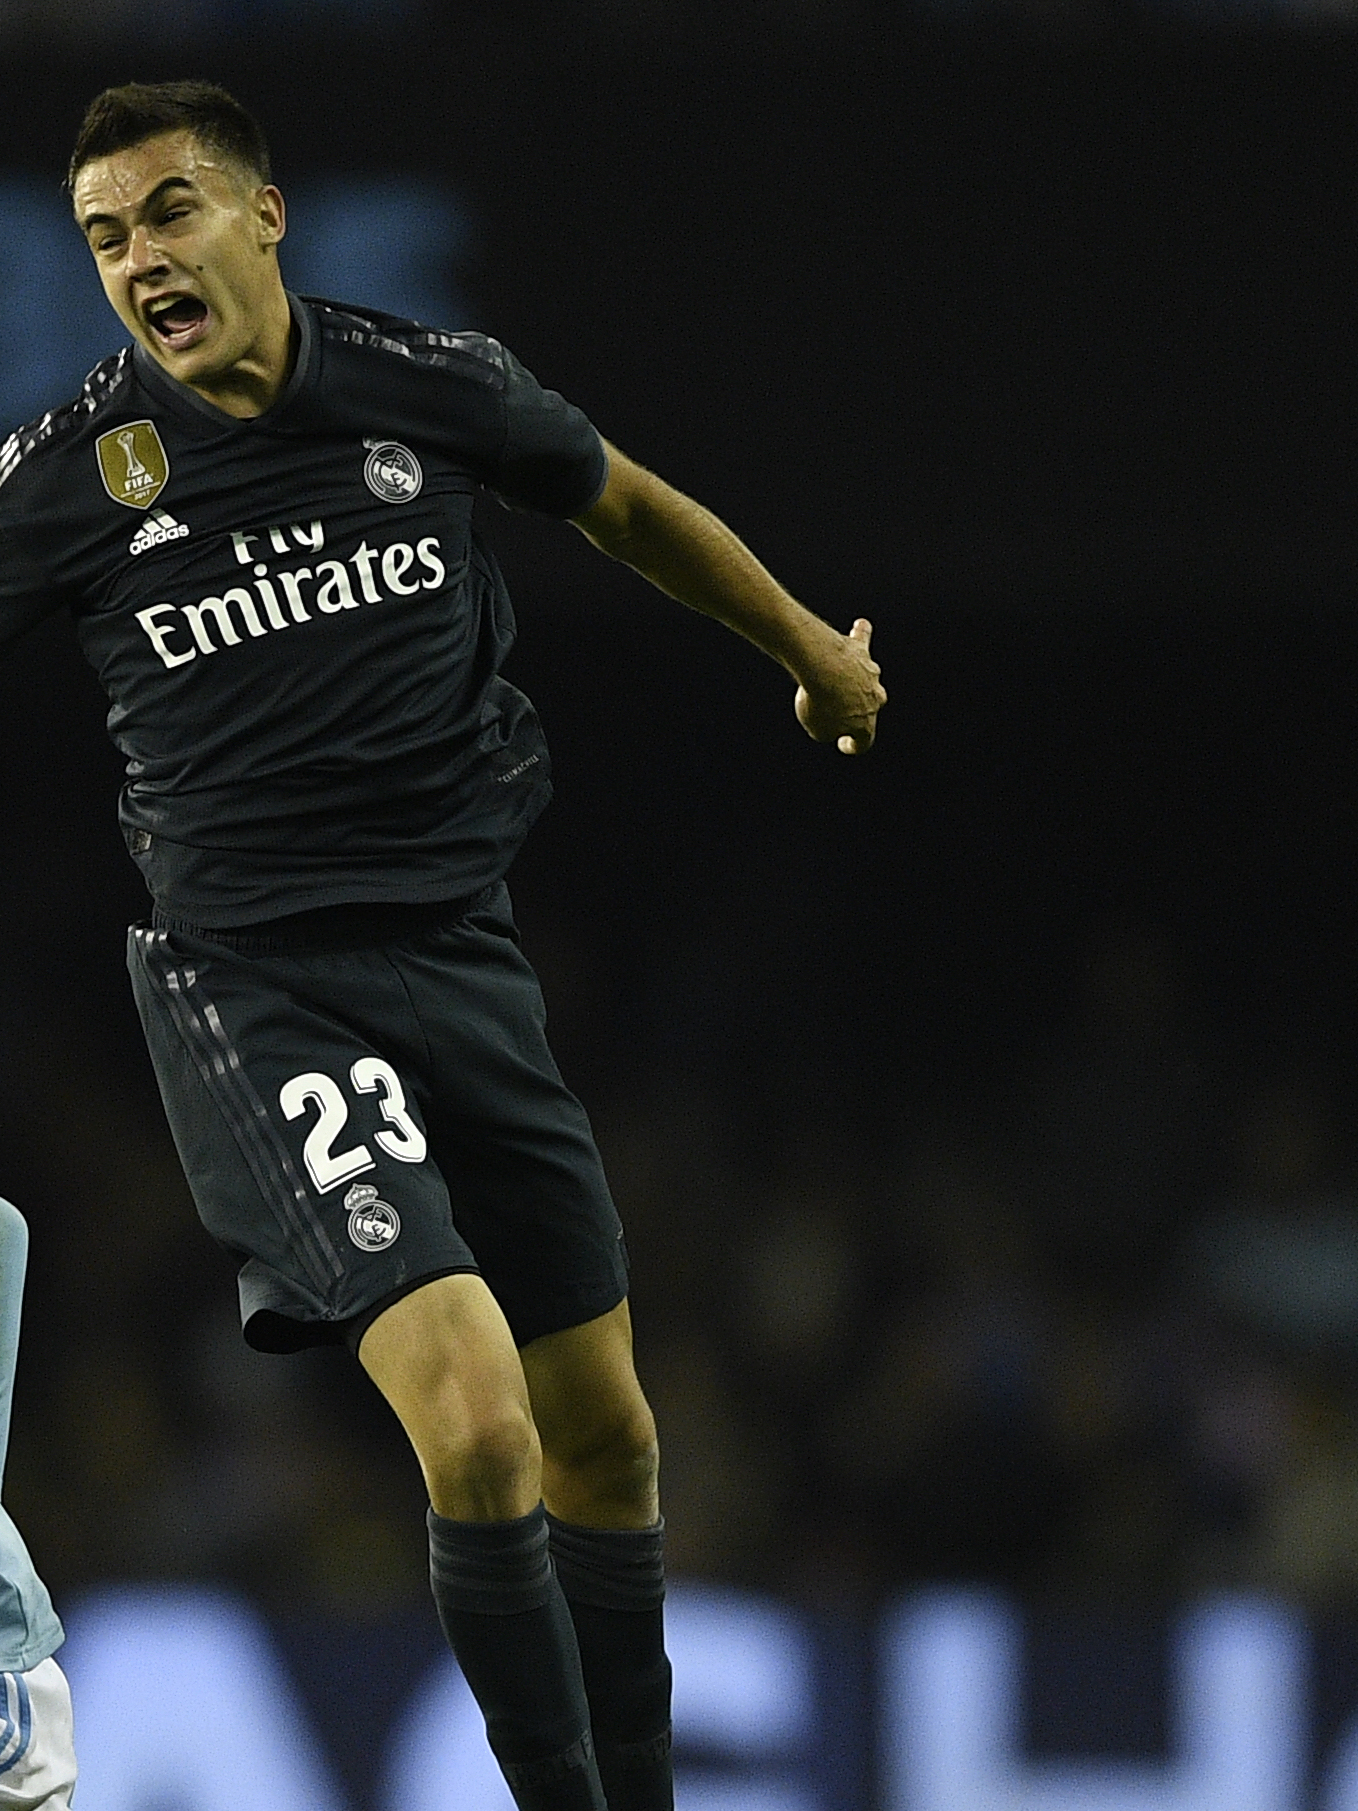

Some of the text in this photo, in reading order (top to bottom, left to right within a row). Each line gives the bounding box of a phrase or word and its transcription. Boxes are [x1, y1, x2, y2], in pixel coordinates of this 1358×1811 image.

[124, 473, 153, 491] FIFA
[129, 523, 190, 556] adidas
[135, 536, 447, 670] Emirates
[280, 1056, 427, 1195] 23
